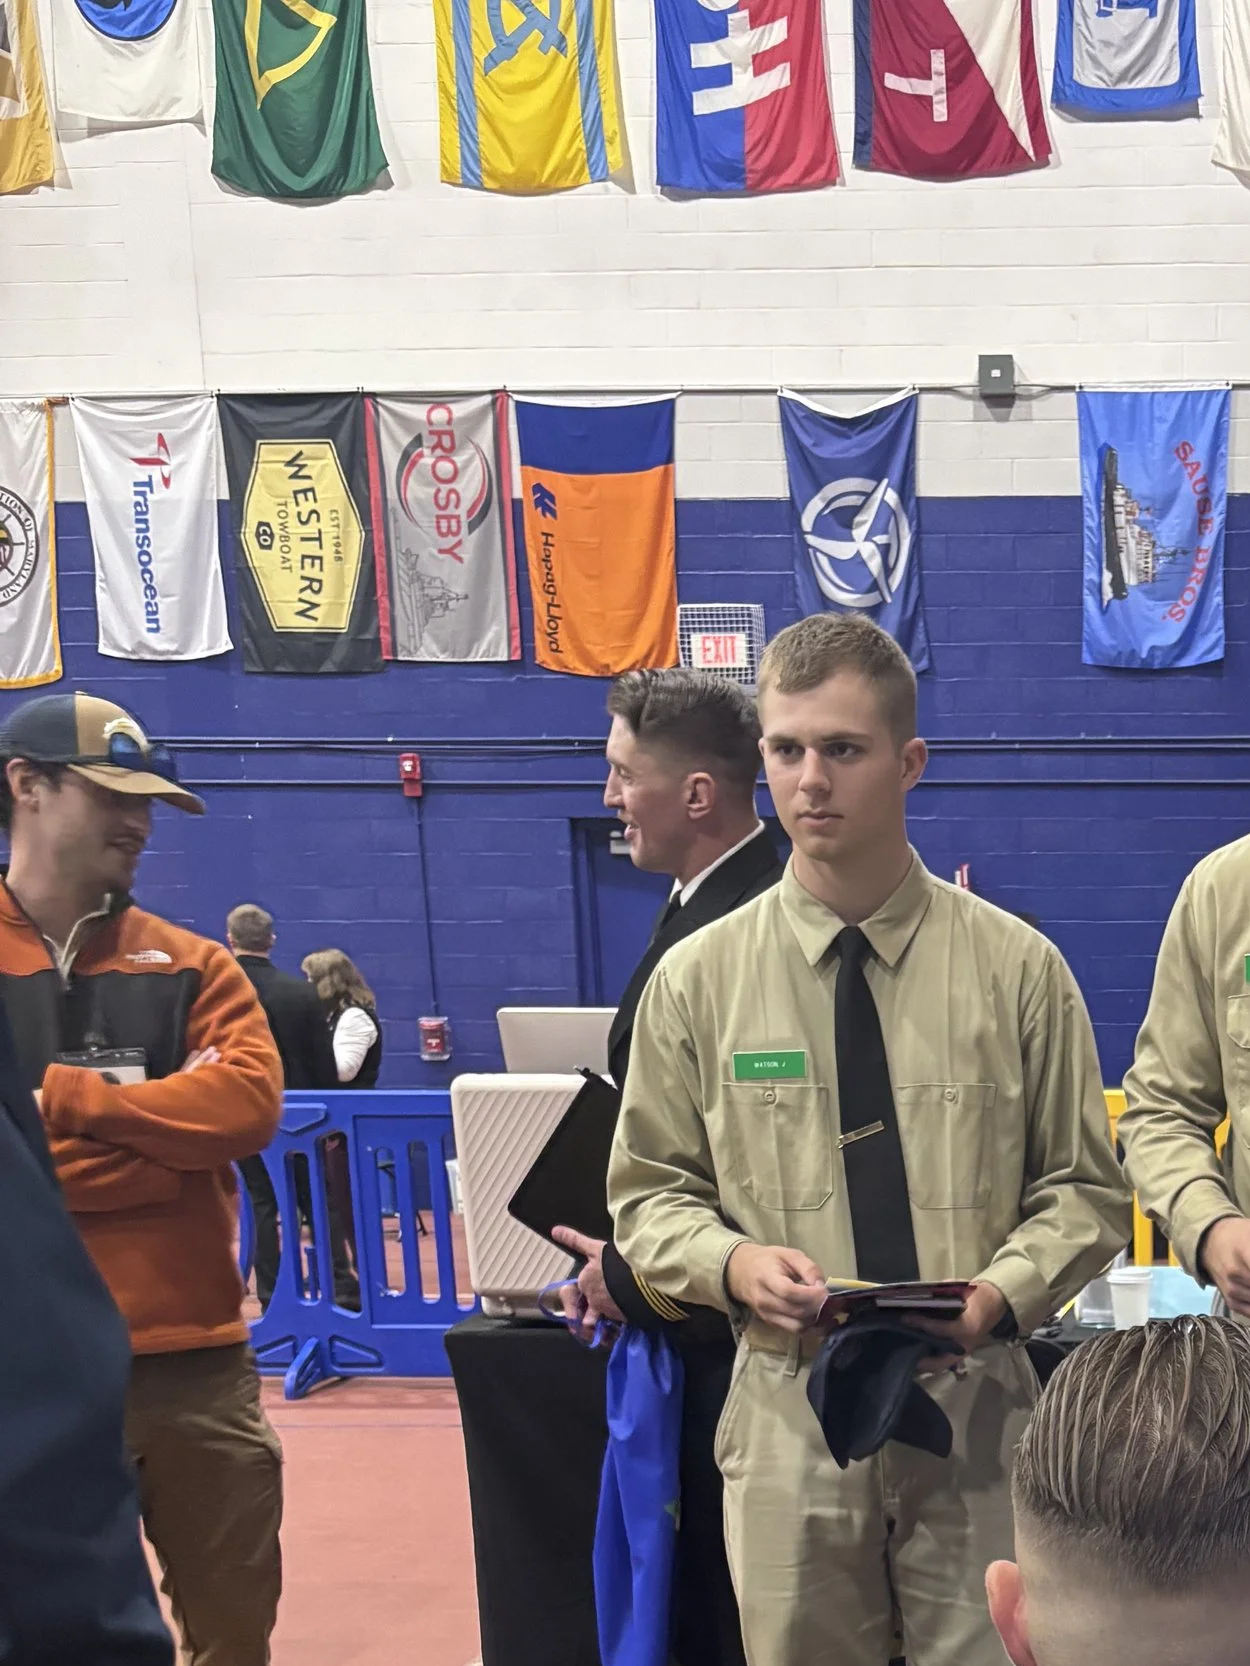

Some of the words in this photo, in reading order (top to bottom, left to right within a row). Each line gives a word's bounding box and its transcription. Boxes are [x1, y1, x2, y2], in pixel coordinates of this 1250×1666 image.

[257, 525, 271, 545] CO
[276, 500, 293, 573] TOWBOAT
[284, 450, 324, 622] WESTERN
[426, 403, 464, 565] CROSBY
[1174, 440, 1214, 536] SAUSE
[132, 474, 161, 634] Transocean
[540, 531, 563, 654] Hapag-Lloyd
[702, 635, 736, 664] EXIT
